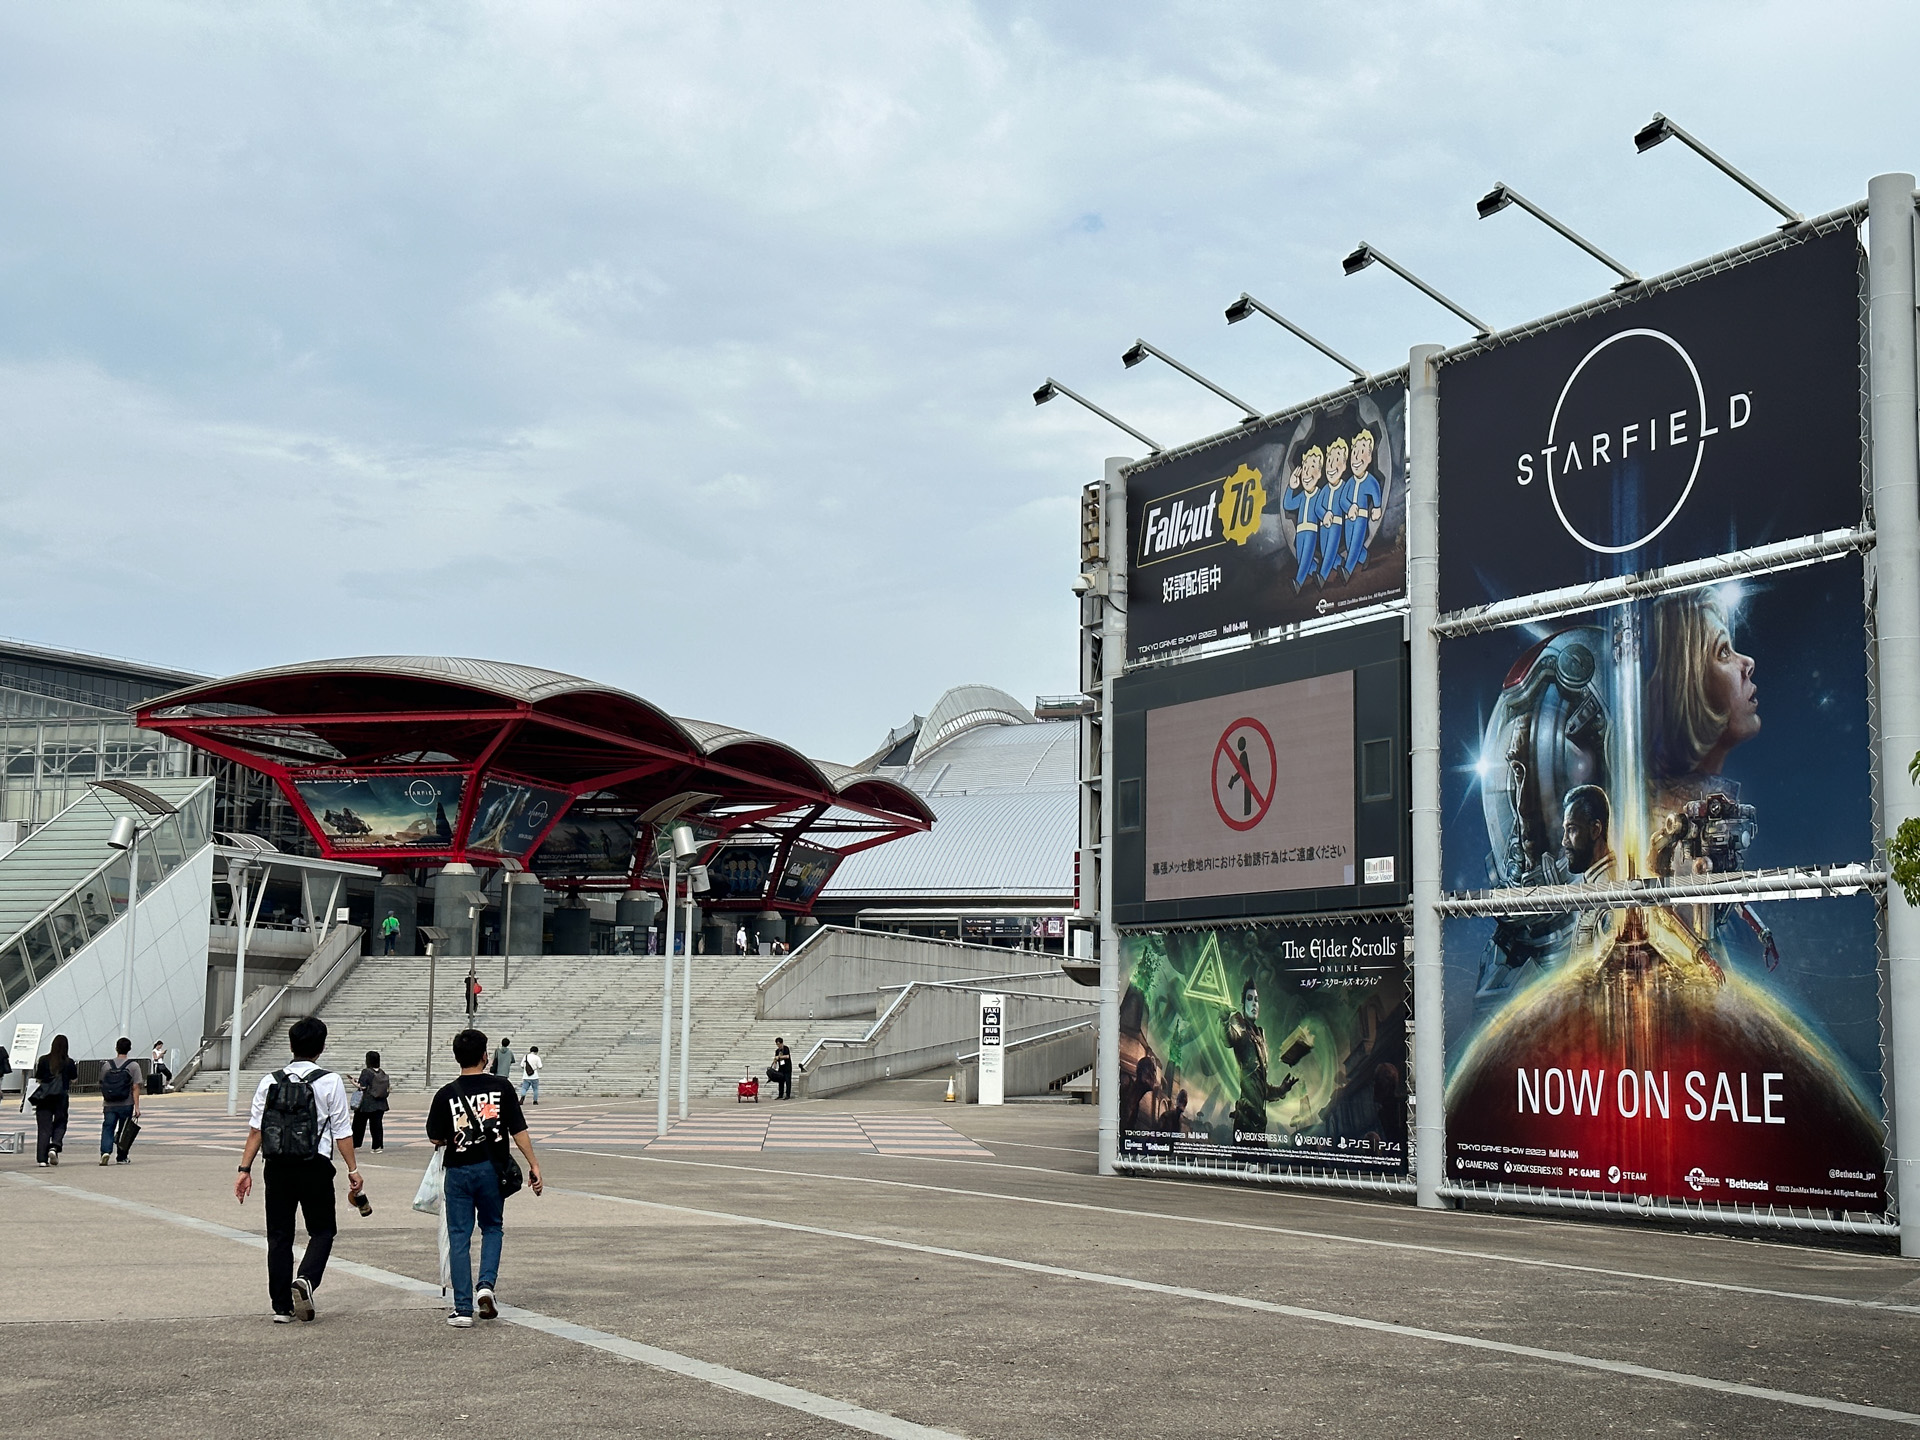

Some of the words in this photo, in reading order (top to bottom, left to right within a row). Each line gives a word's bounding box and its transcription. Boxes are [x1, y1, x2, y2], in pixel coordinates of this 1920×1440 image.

[1516, 392, 1752, 486] STARFIELD
[1143, 489, 1217, 557] Fallout
[1229, 479, 1256, 531] 76
[1162, 564, 1222, 604] 好評配信中
[1138, 644, 1158, 653] TOKYO
[1159, 638, 1178, 648] GAME
[1178, 633, 1198, 645] SHOW
[1198, 629, 1217, 640] 2023
[1152, 844, 1347, 876] 幕張メッセ敷地内における勧誘行為はご遠慮ください
[1281, 940, 1306, 959] The
[1309, 938, 1348, 963] Elder
[1349, 936, 1397, 958] Scrolls
[1320, 964, 1359, 973] ONLINE
[1516, 1067, 1606, 1117] NOW
[1617, 1068, 1670, 1120] ON
[1684, 1070, 1786, 1124] SALE
[449, 1091, 501, 1116] HYPE
[1243, 1132, 1258, 1141] XBOX
[1258, 1133, 1278, 1142] SERIES
[1303, 1135, 1318, 1145] XBOX
[1318, 1136, 1332, 1146] ONE
[1349, 1139, 1370, 1149] PS5
[1378, 1141, 1401, 1151] PS4
[1457, 1143, 1480, 1152] TOKYO
[1481, 1144, 1502, 1153] GAME
[1502, 1146, 1525, 1155] SHOW
[1525, 1148, 1546, 1157] 2023
[1549, 1149, 1559, 1158] Hall
[1465, 1160, 1483, 1169] GAME
[1483, 1161, 1498, 1171] PASS
[1513, 1164, 1530, 1173] XBOX
[1530, 1165, 1551, 1174] SERIES
[1569, 1167, 1578, 1177] PC
[1580, 1168, 1600, 1178] GAME
[1622, 1171, 1647, 1181] STEAM
[1729, 1178, 1769, 1191] Bethesda
[1790, 1185, 1809, 1194] ZeniMax
[1809, 1187, 1824, 1195] Media
